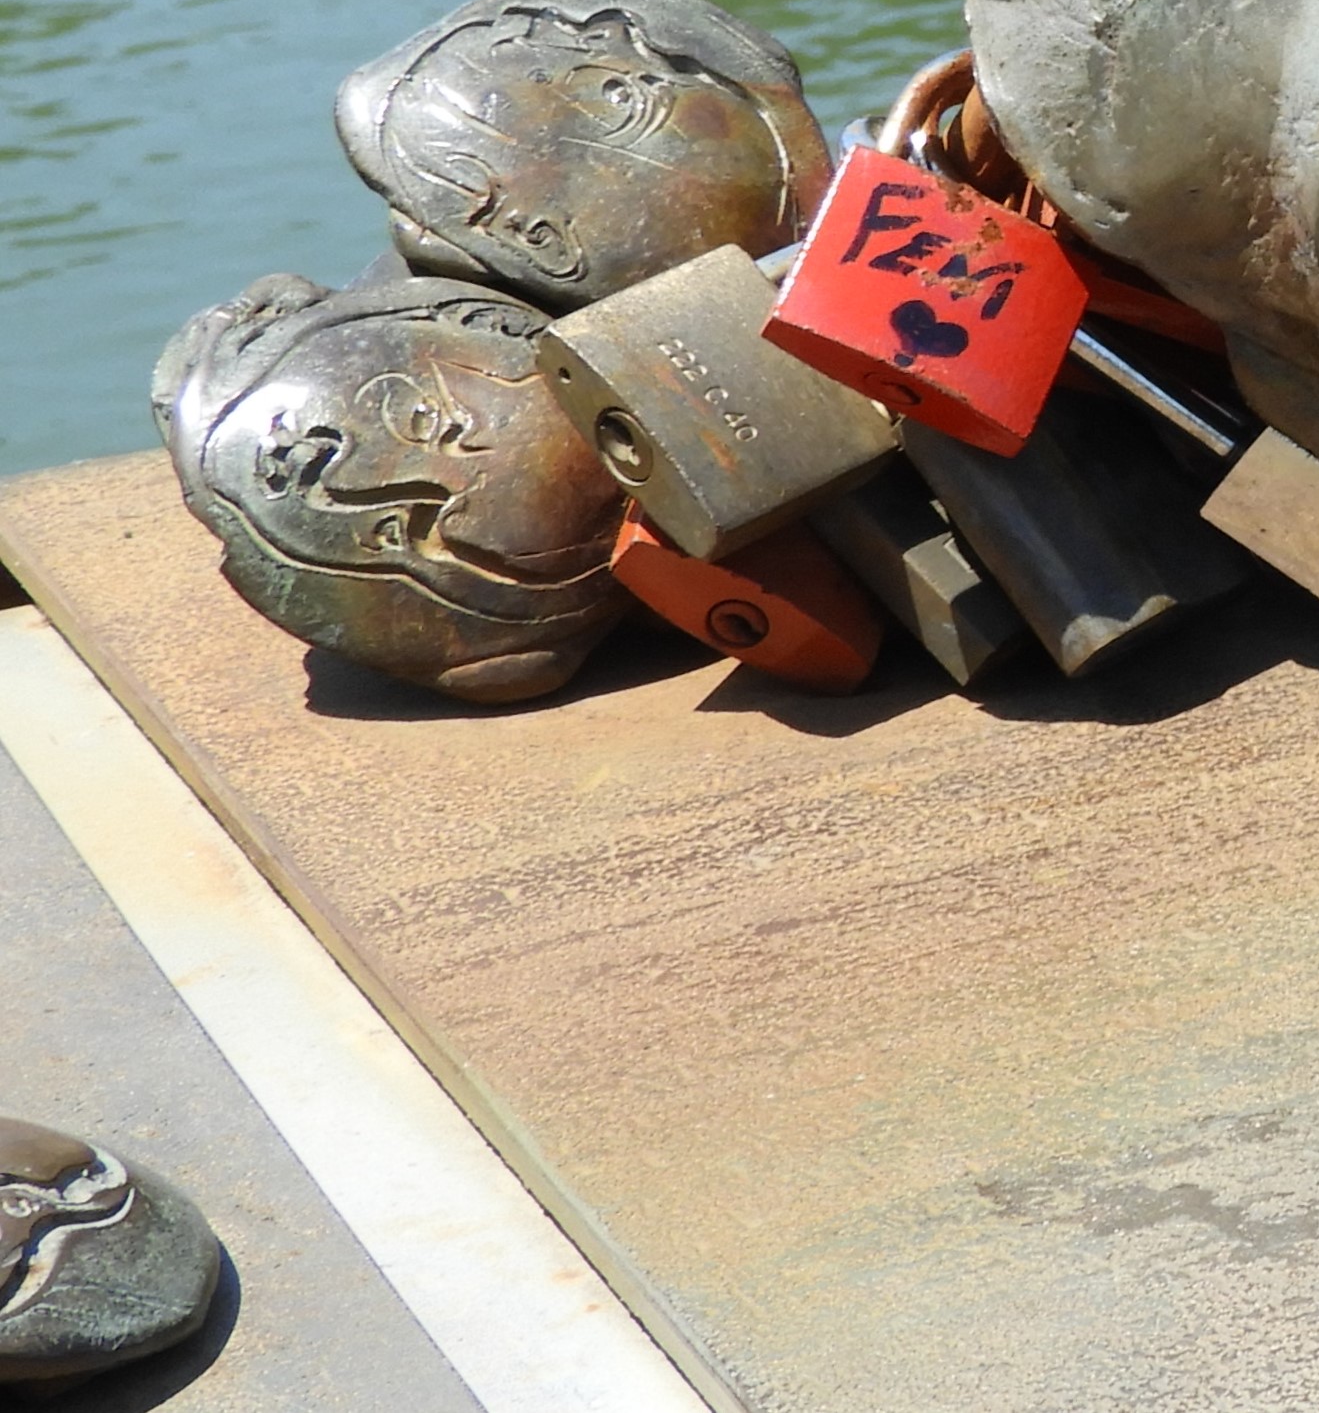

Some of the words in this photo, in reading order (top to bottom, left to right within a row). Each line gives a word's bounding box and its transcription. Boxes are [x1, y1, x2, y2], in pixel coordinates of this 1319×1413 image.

[657, 337, 708, 382] 222
[704, 385, 729, 406] C
[723, 412, 758, 442] 40
